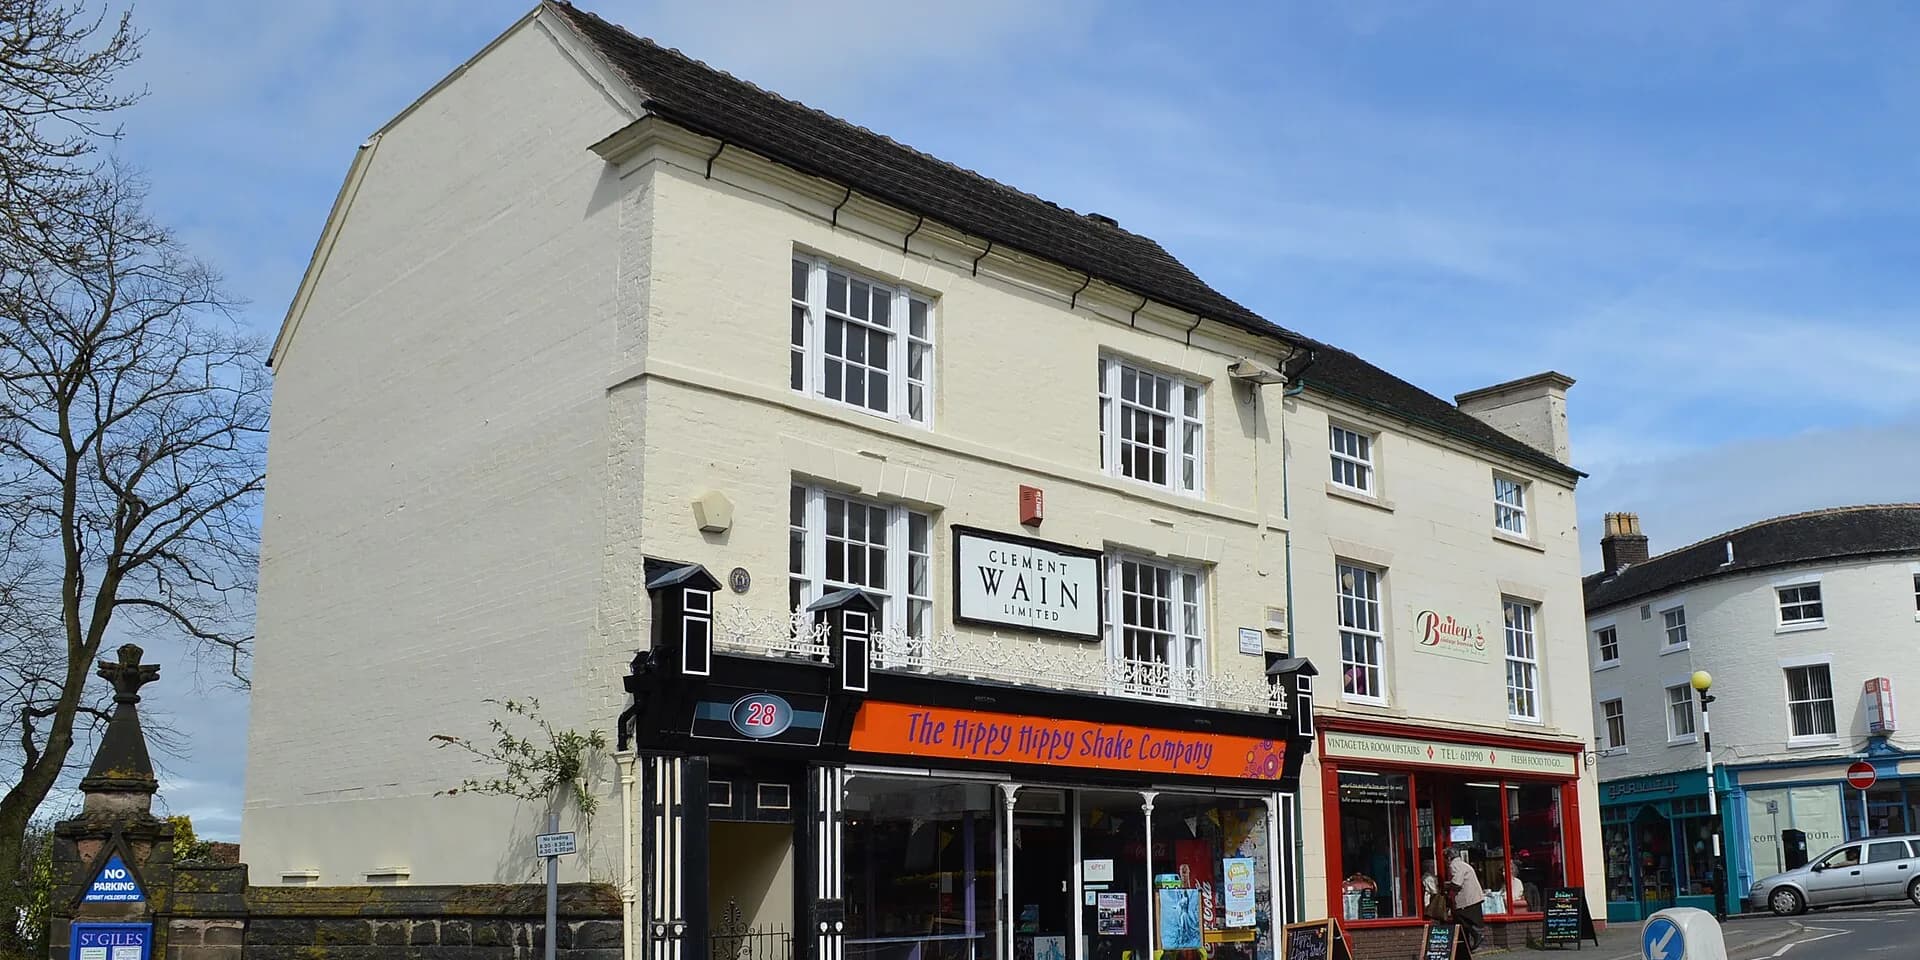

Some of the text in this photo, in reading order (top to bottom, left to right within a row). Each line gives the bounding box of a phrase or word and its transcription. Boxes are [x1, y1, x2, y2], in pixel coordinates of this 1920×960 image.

[989, 550, 1067, 575] CLEMENT
[978, 566, 1078, 610] WAIN
[1004, 604, 1059, 621] LIMITED
[745, 702, 776, 727] 28
[908, 711, 1213, 770] The Hippy Hippy Shake Company
[1327, 738, 1421, 755] VINTAGE TEA ROOM UPSTAIRS
[1440, 748, 1484, 762] TEL: 611990
[1511, 755, 1528, 765] FRESH
[1528, 757, 1544, 766] FOOD
[1544, 758, 1551, 766] TO
[1753, 831, 1840, 843] com oon...
[104, 869, 126, 879] NO
[93, 882, 135, 891] PARKING
[97, 933, 143, 945] GILES
